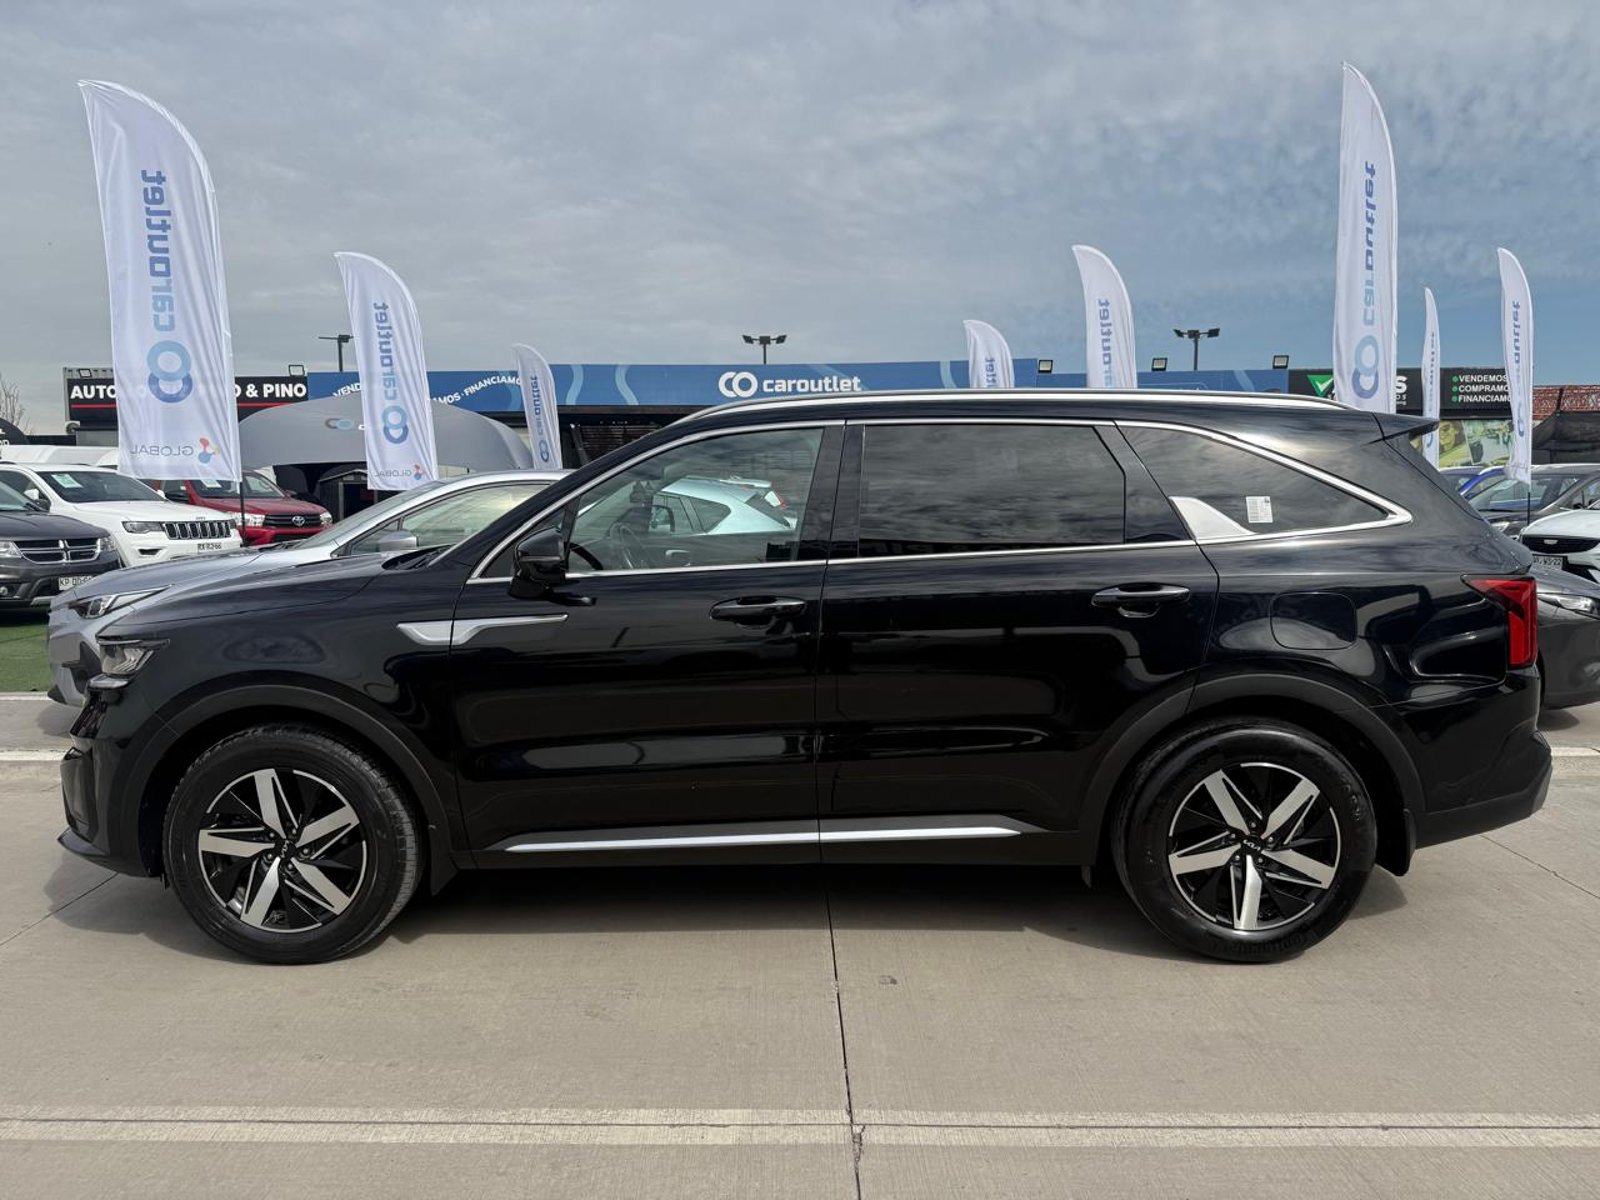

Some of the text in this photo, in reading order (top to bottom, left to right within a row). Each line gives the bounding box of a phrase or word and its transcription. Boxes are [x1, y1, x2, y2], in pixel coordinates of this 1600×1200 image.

[762, 376, 862, 393] caroutlet
[1459, 374, 1509, 383] VENDEMOS
[263, 383, 306, 398] PINO
